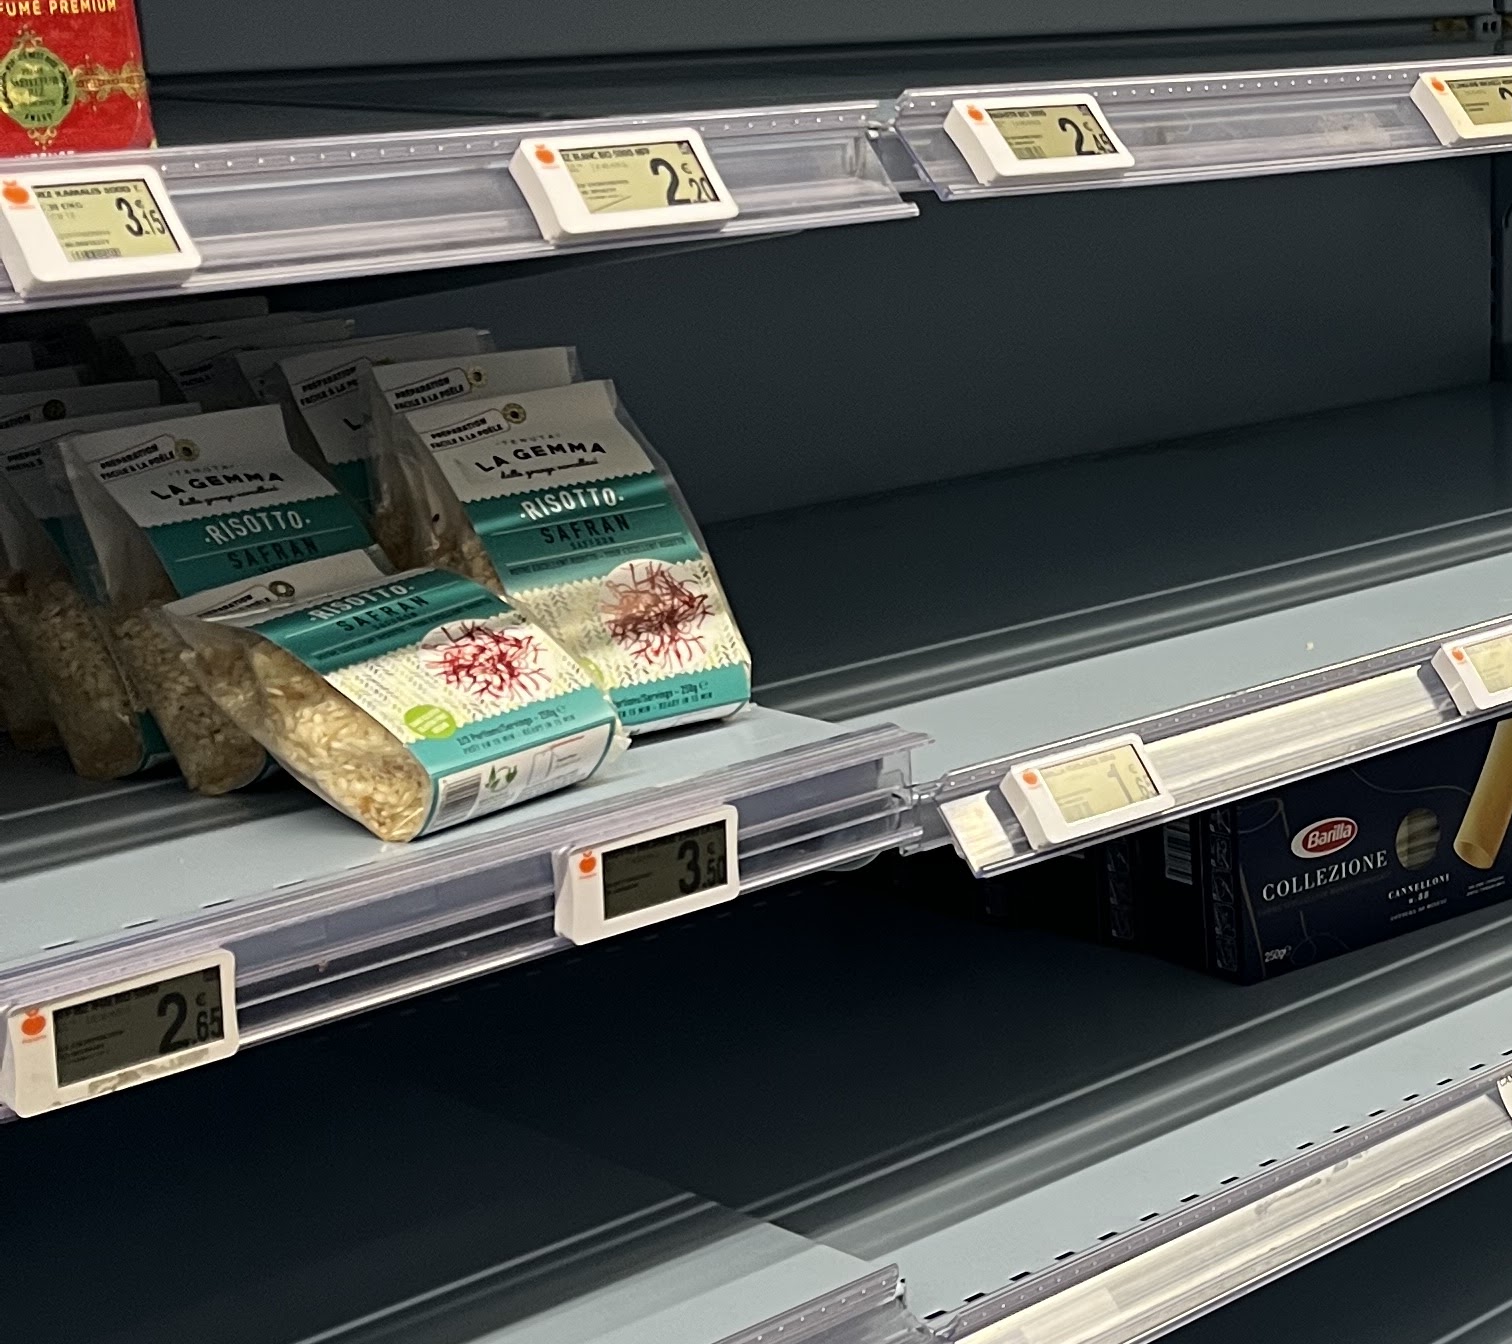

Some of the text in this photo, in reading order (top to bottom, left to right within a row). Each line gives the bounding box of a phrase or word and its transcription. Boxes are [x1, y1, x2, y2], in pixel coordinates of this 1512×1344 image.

[649, 157, 716, 206] 2.20
[115, 197, 166, 237] 3.15
[475, 455, 510, 472] LA
[512, 442, 607, 460] GEMMA
[150, 484, 187, 500] LA
[188, 472, 284, 490] GEMMA
[519, 487, 617, 520] RISOTTO
[204, 510, 304, 545] RISOTTO
[540, 513, 631, 544] SAFRAN
[227, 537, 318, 570] SAFRAN
[308, 584, 408, 620] RISOTTO
[336, 595, 430, 631] SAFRAN
[1307, 822, 1352, 850] Barilla
[1262, 849, 1388, 902] COLLEZIONE
[1388, 872, 1450, 900] CANNELLONI
[155, 992, 221, 1055] 2.65
